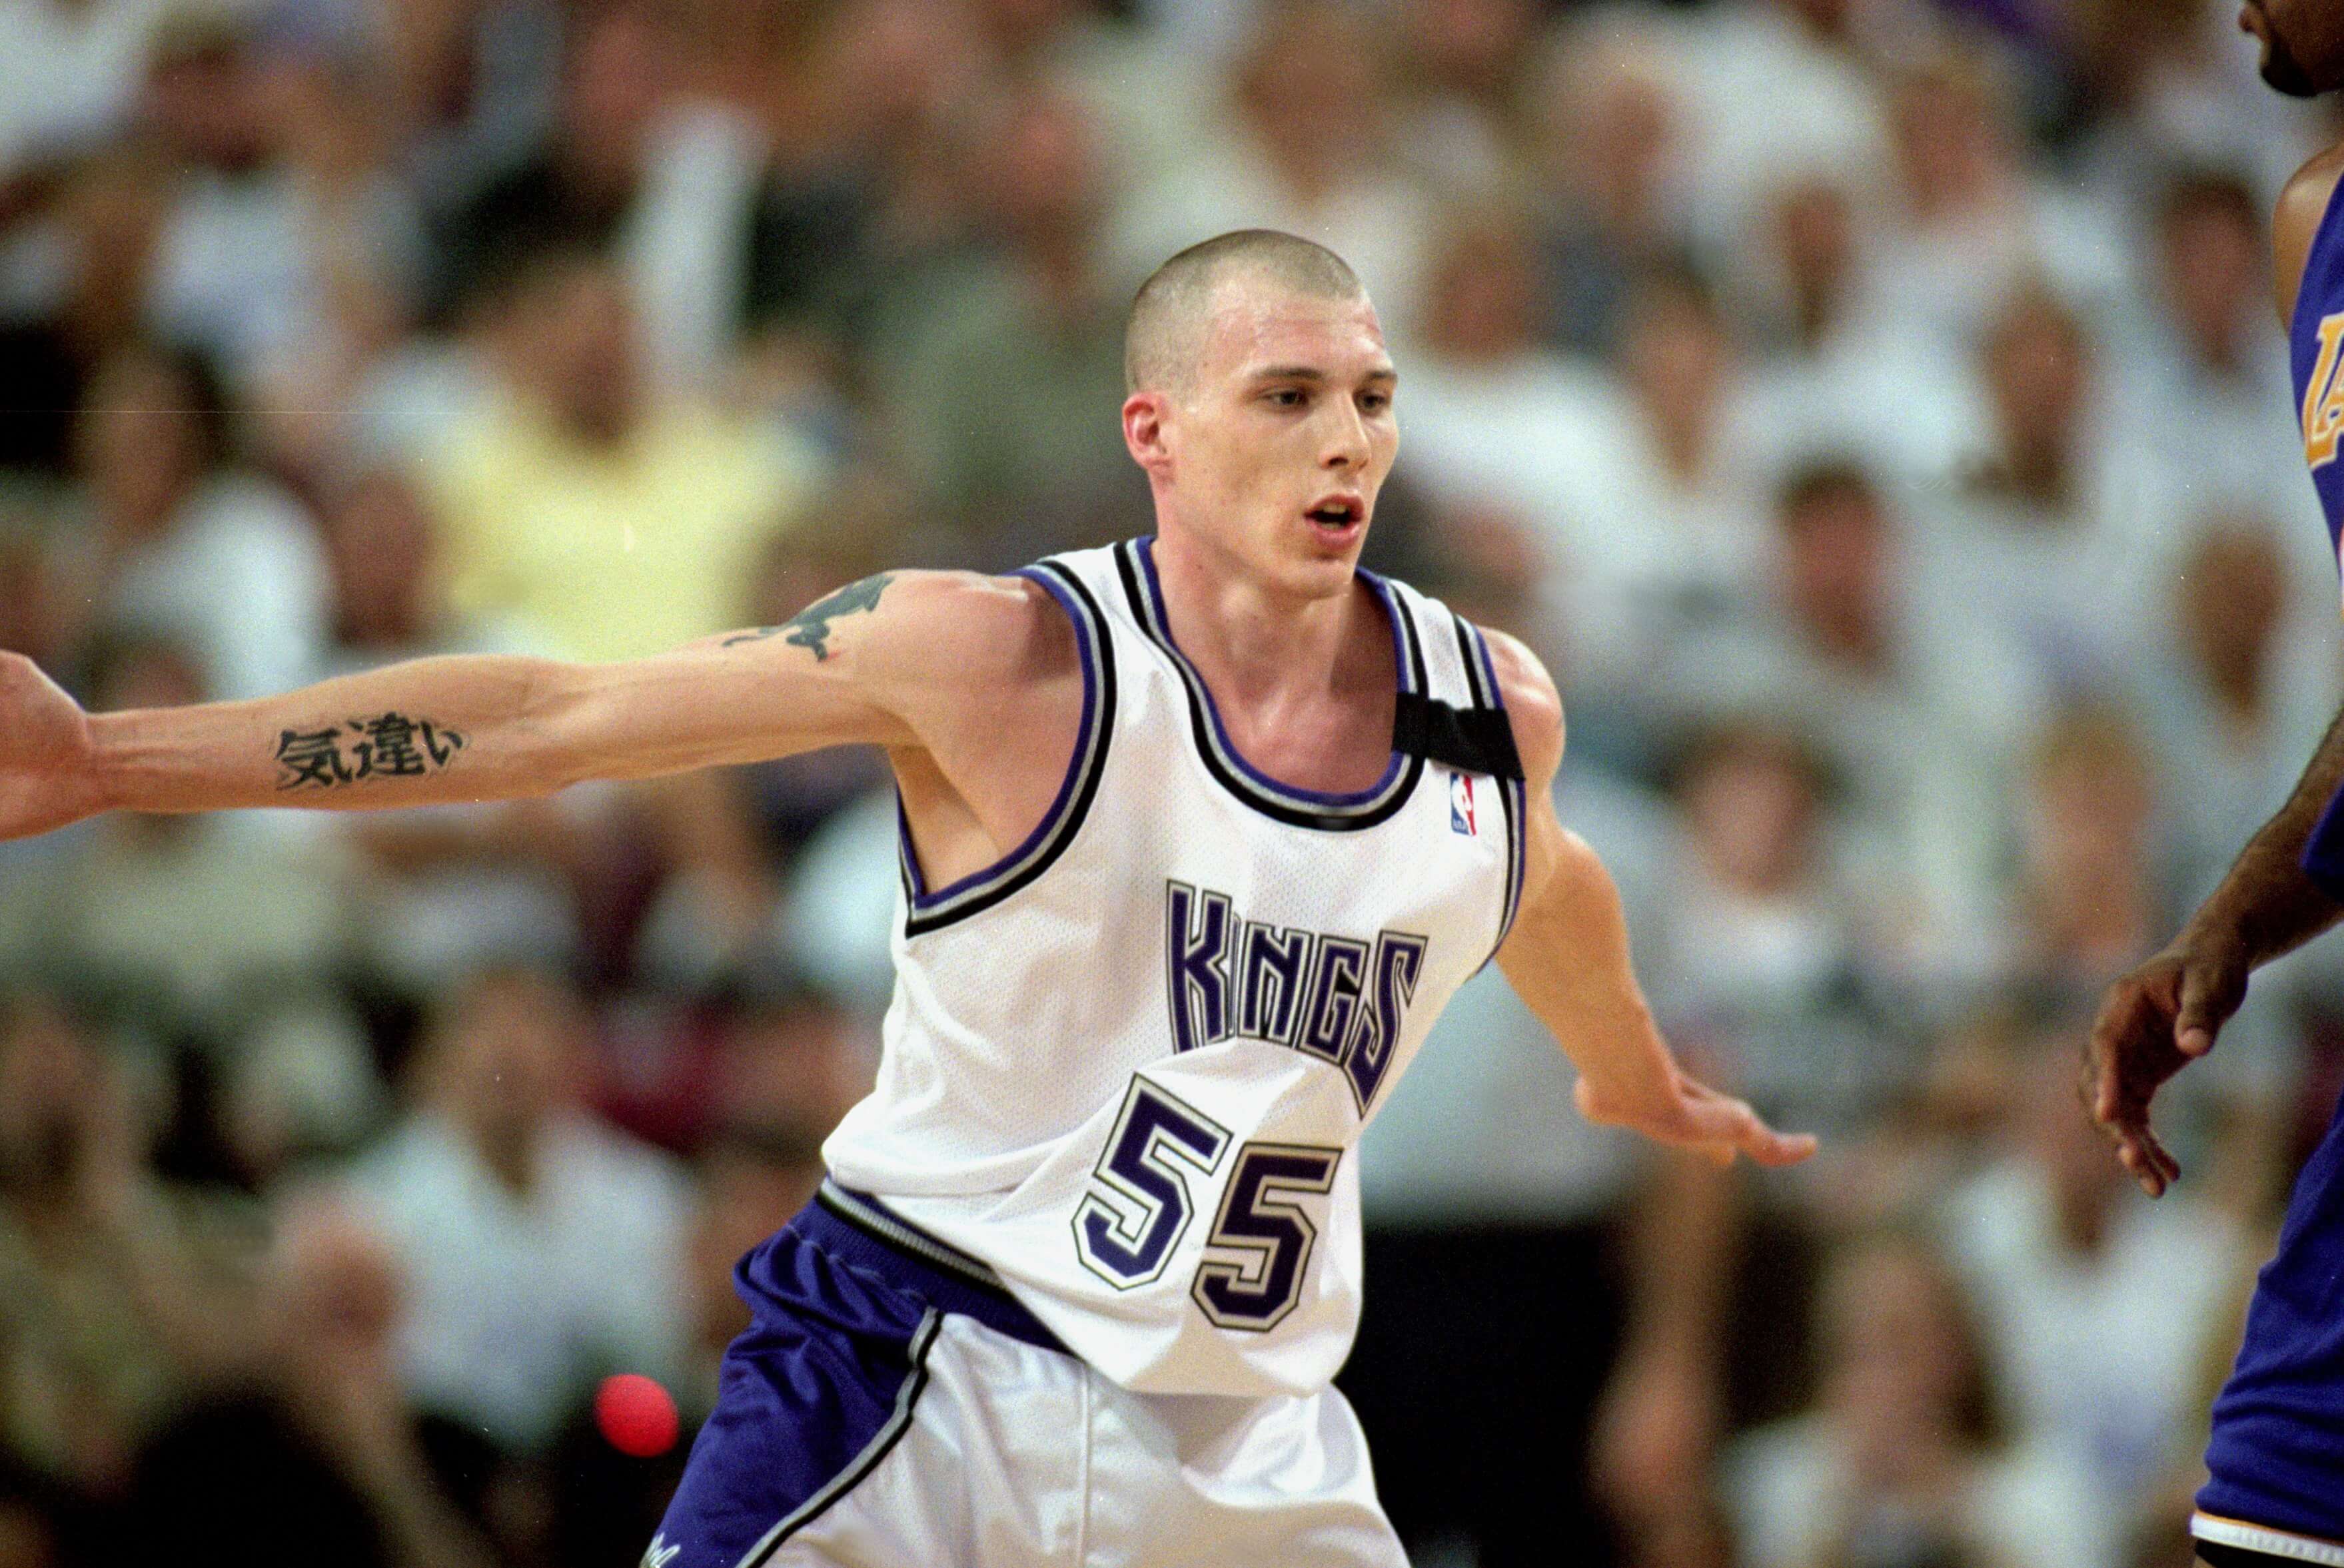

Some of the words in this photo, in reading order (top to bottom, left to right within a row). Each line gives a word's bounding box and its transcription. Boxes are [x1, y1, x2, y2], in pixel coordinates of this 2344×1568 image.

[275, 711, 464, 791] 気違い
[1071, 1072, 1344, 1333] 55
